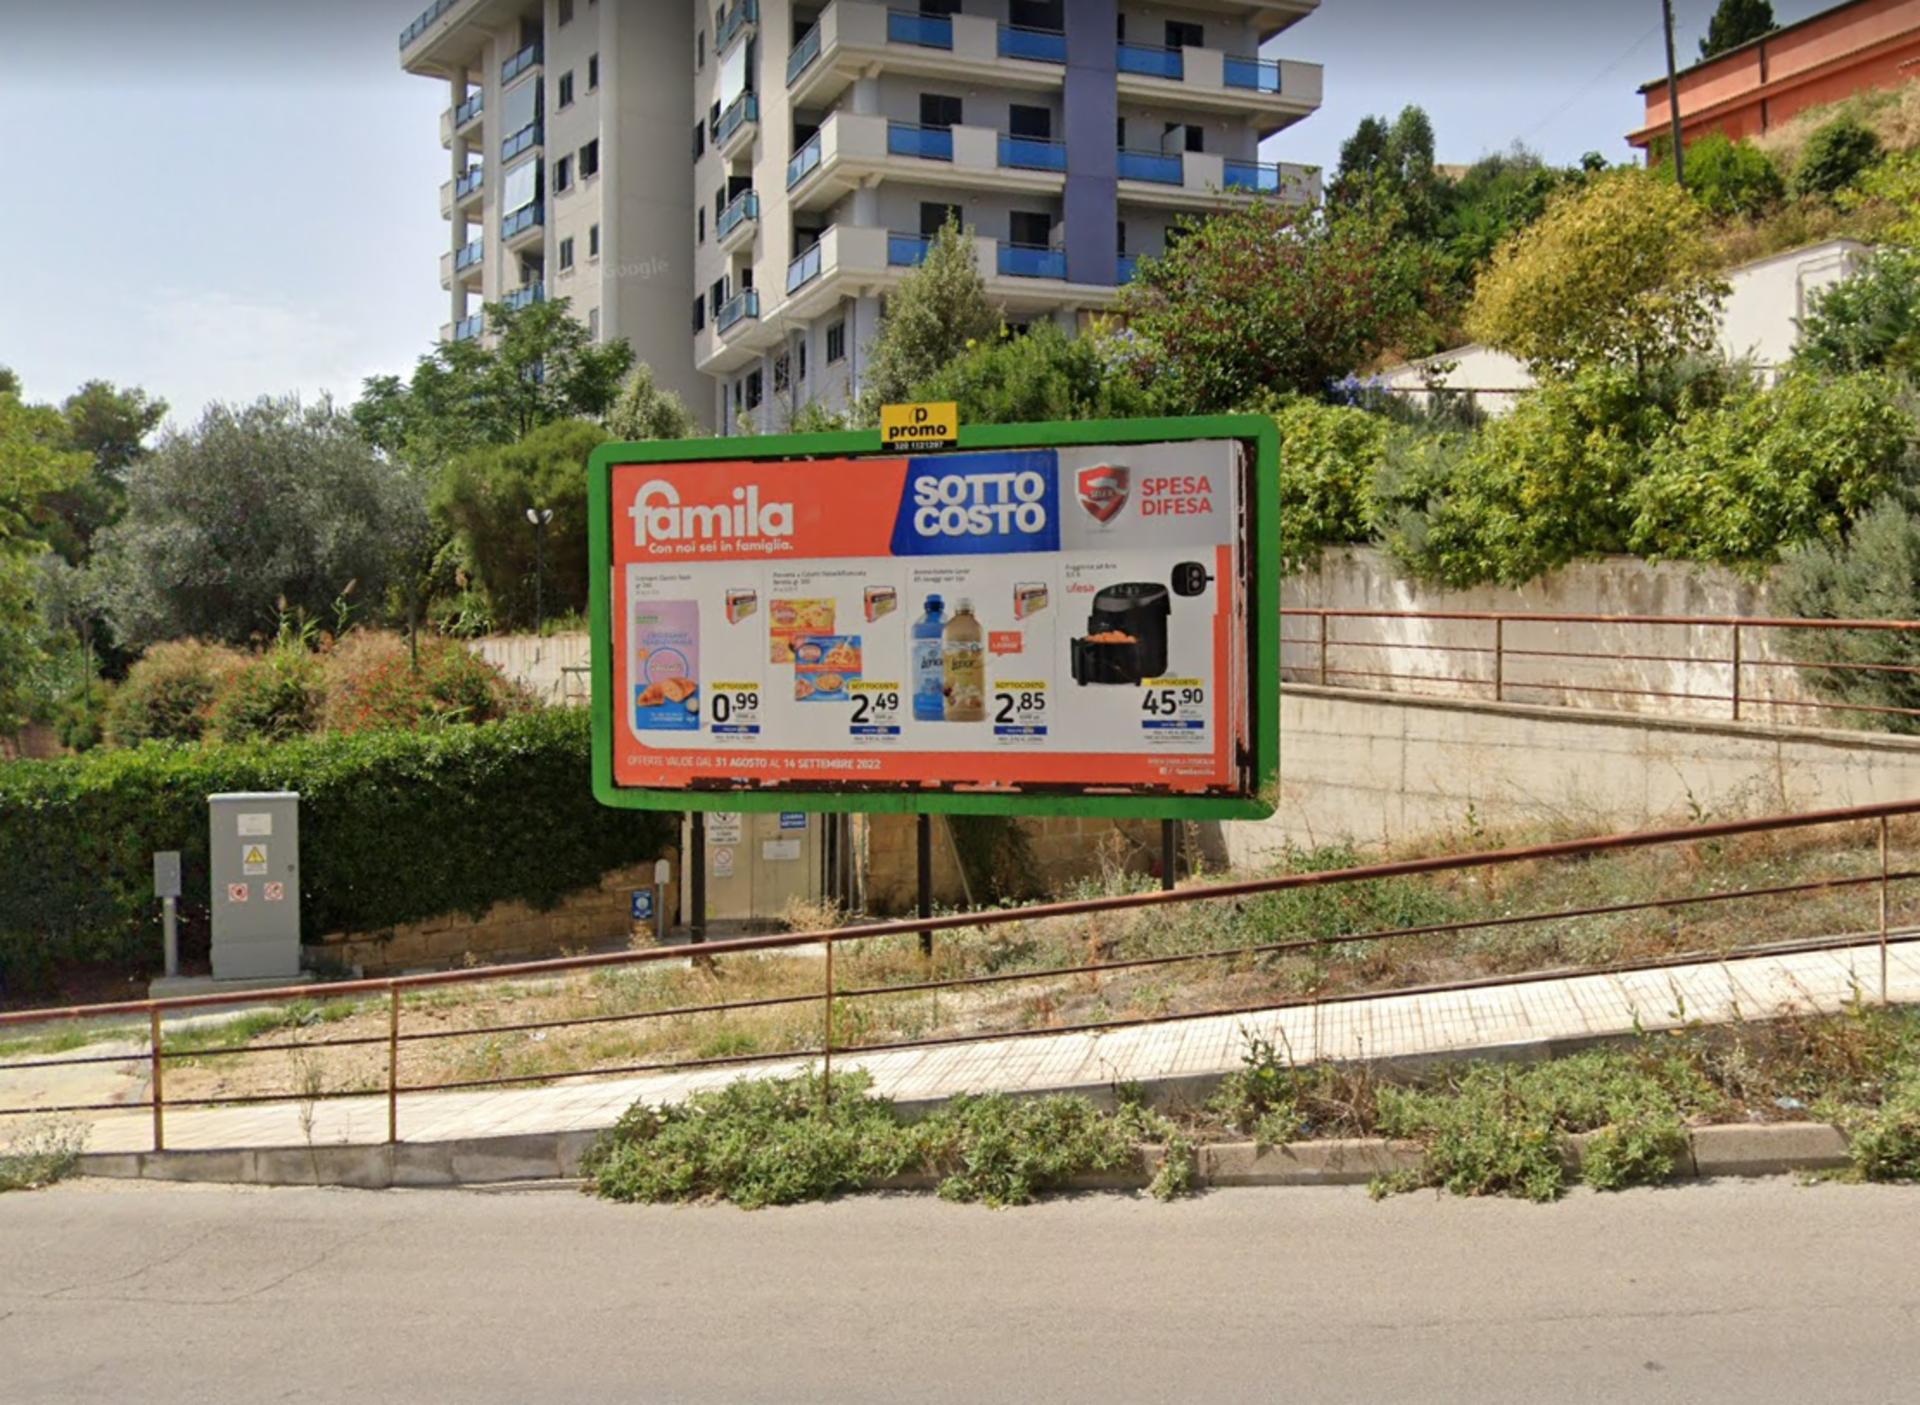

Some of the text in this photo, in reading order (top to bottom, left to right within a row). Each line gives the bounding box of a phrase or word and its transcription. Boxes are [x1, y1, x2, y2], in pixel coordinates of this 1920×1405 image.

[889, 424, 947, 439] promo
[914, 470, 1045, 506] SOTTO
[1141, 475, 1213, 497] SPESA
[628, 479, 794, 547] famila
[914, 502, 1046, 536] COSTO
[1141, 497, 1213, 516] DIFESA
[649, 539, 793, 554] Con noi sei in famiglia.
[712, 692, 758, 723] 0,99
[851, 692, 899, 723] 2,49
[995, 692, 1045, 723] 2,85
[1142, 688, 1204, 715] 45,90
[627, 755, 663, 767] OFFERTE
[666, 756, 694, 767] VALIDE
[695, 757, 712, 767] DAL
[715, 756, 727, 767] 31
[729, 756, 768, 768] AGOSTO
[798, 758, 855, 769] SETTEMBRE
[856, 759, 881, 769] 2022
